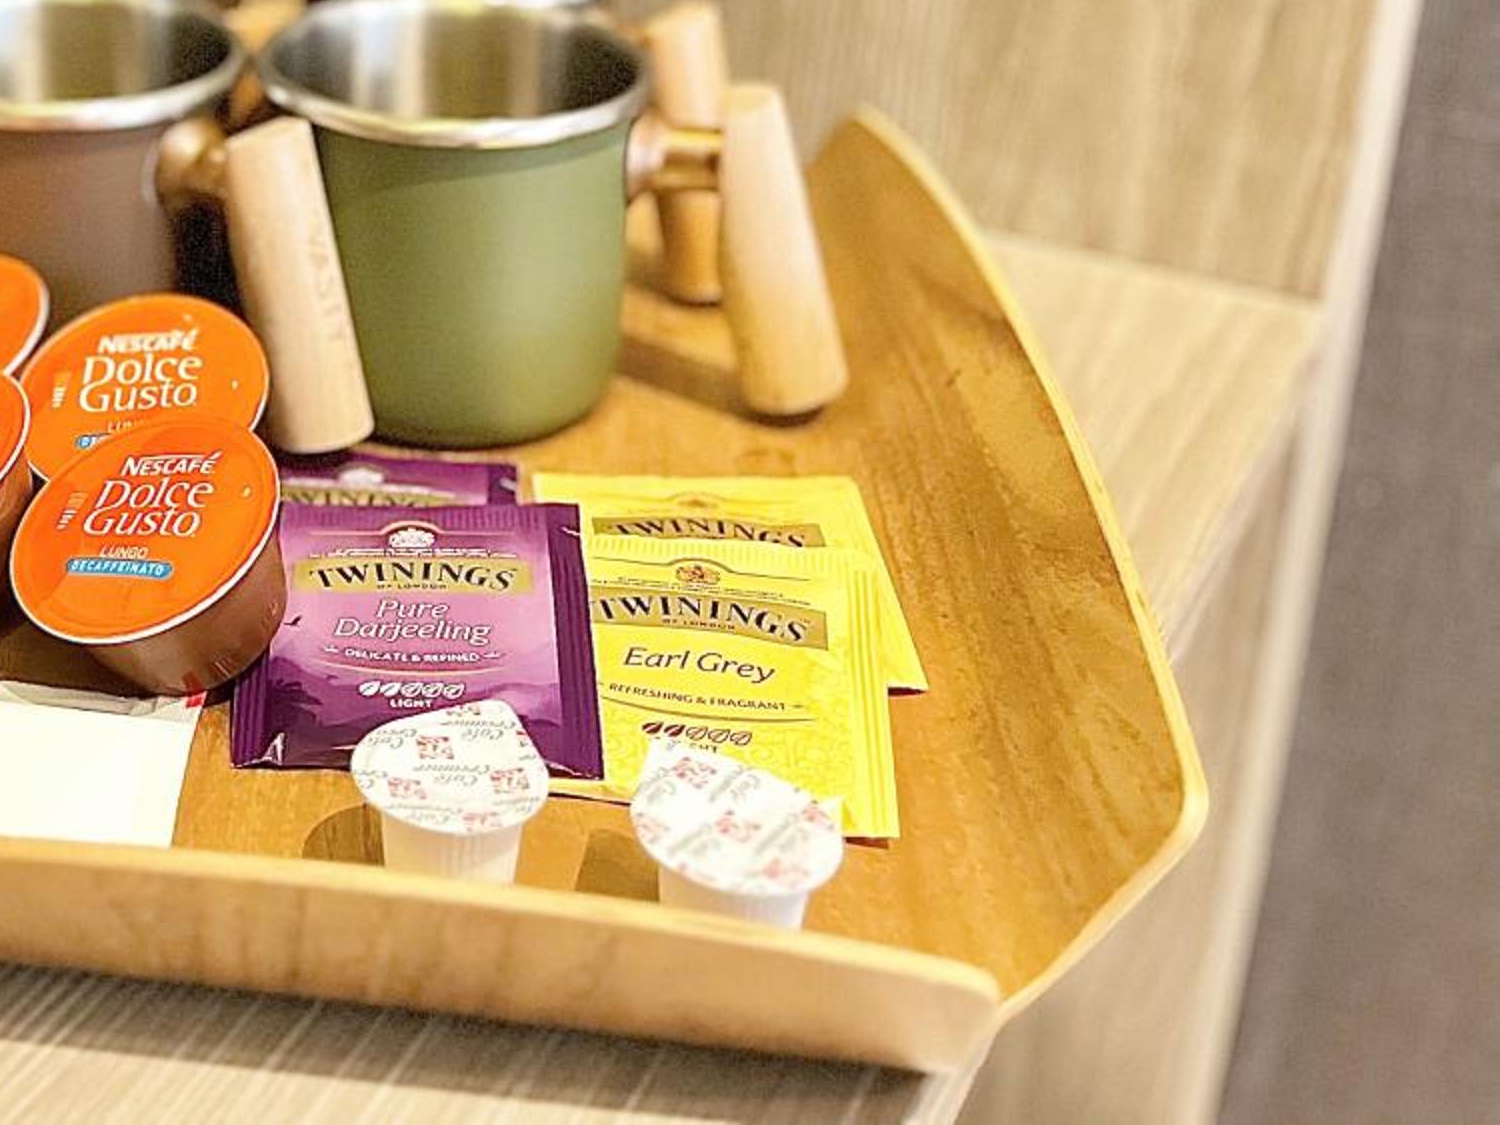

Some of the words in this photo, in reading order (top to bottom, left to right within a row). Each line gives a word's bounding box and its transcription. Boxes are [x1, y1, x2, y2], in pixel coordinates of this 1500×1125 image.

[83, 353, 203, 384] Dolce
[79, 379, 197, 412] Gusto
[121, 450, 223, 476] NESCAFÉ
[95, 477, 214, 508] Dolce
[83, 505, 201, 537] Gusto
[100, 546, 149, 559] LUNGO
[71, 560, 165, 576] DECAFFEINATO
[308, 561, 518, 591] TWININGS
[376, 599, 450, 619] Pure
[593, 595, 806, 642] TWININGS
[334, 617, 491, 646] Darjeeling
[344, 648, 409, 662] DELICATE
[411, 654, 421, 663] &
[423, 653, 480, 662] REFINED
[623, 646, 691, 670] Earl
[696, 652, 777, 684] Grey
[389, 698, 434, 708] LIGHT
[608, 682, 694, 704] REFRESHING
[695, 696, 707, 705] &
[709, 696, 787, 711] FRAGRANT
